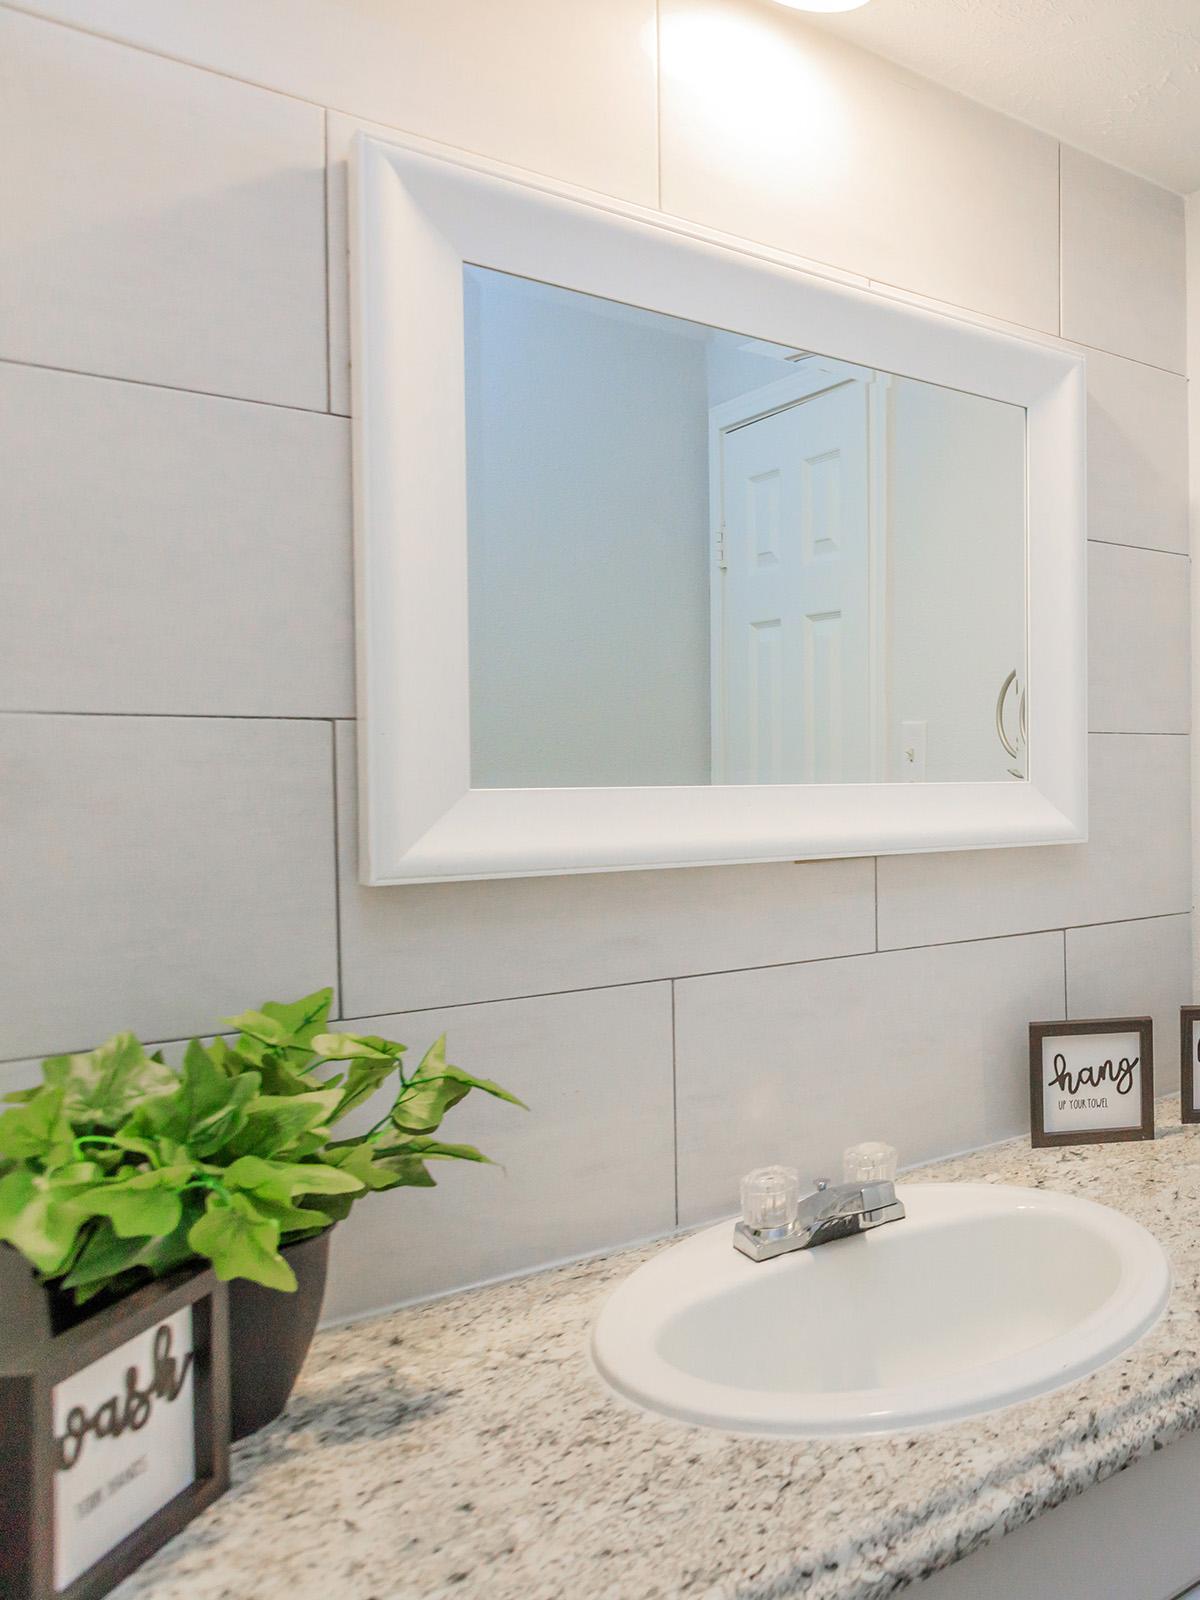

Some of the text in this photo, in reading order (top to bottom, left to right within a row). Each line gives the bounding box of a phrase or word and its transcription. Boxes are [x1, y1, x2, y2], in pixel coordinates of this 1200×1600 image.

[1047, 1053, 1139, 1095] hang
[1058, 1098, 1109, 1110] UP YOUR TOWEL
